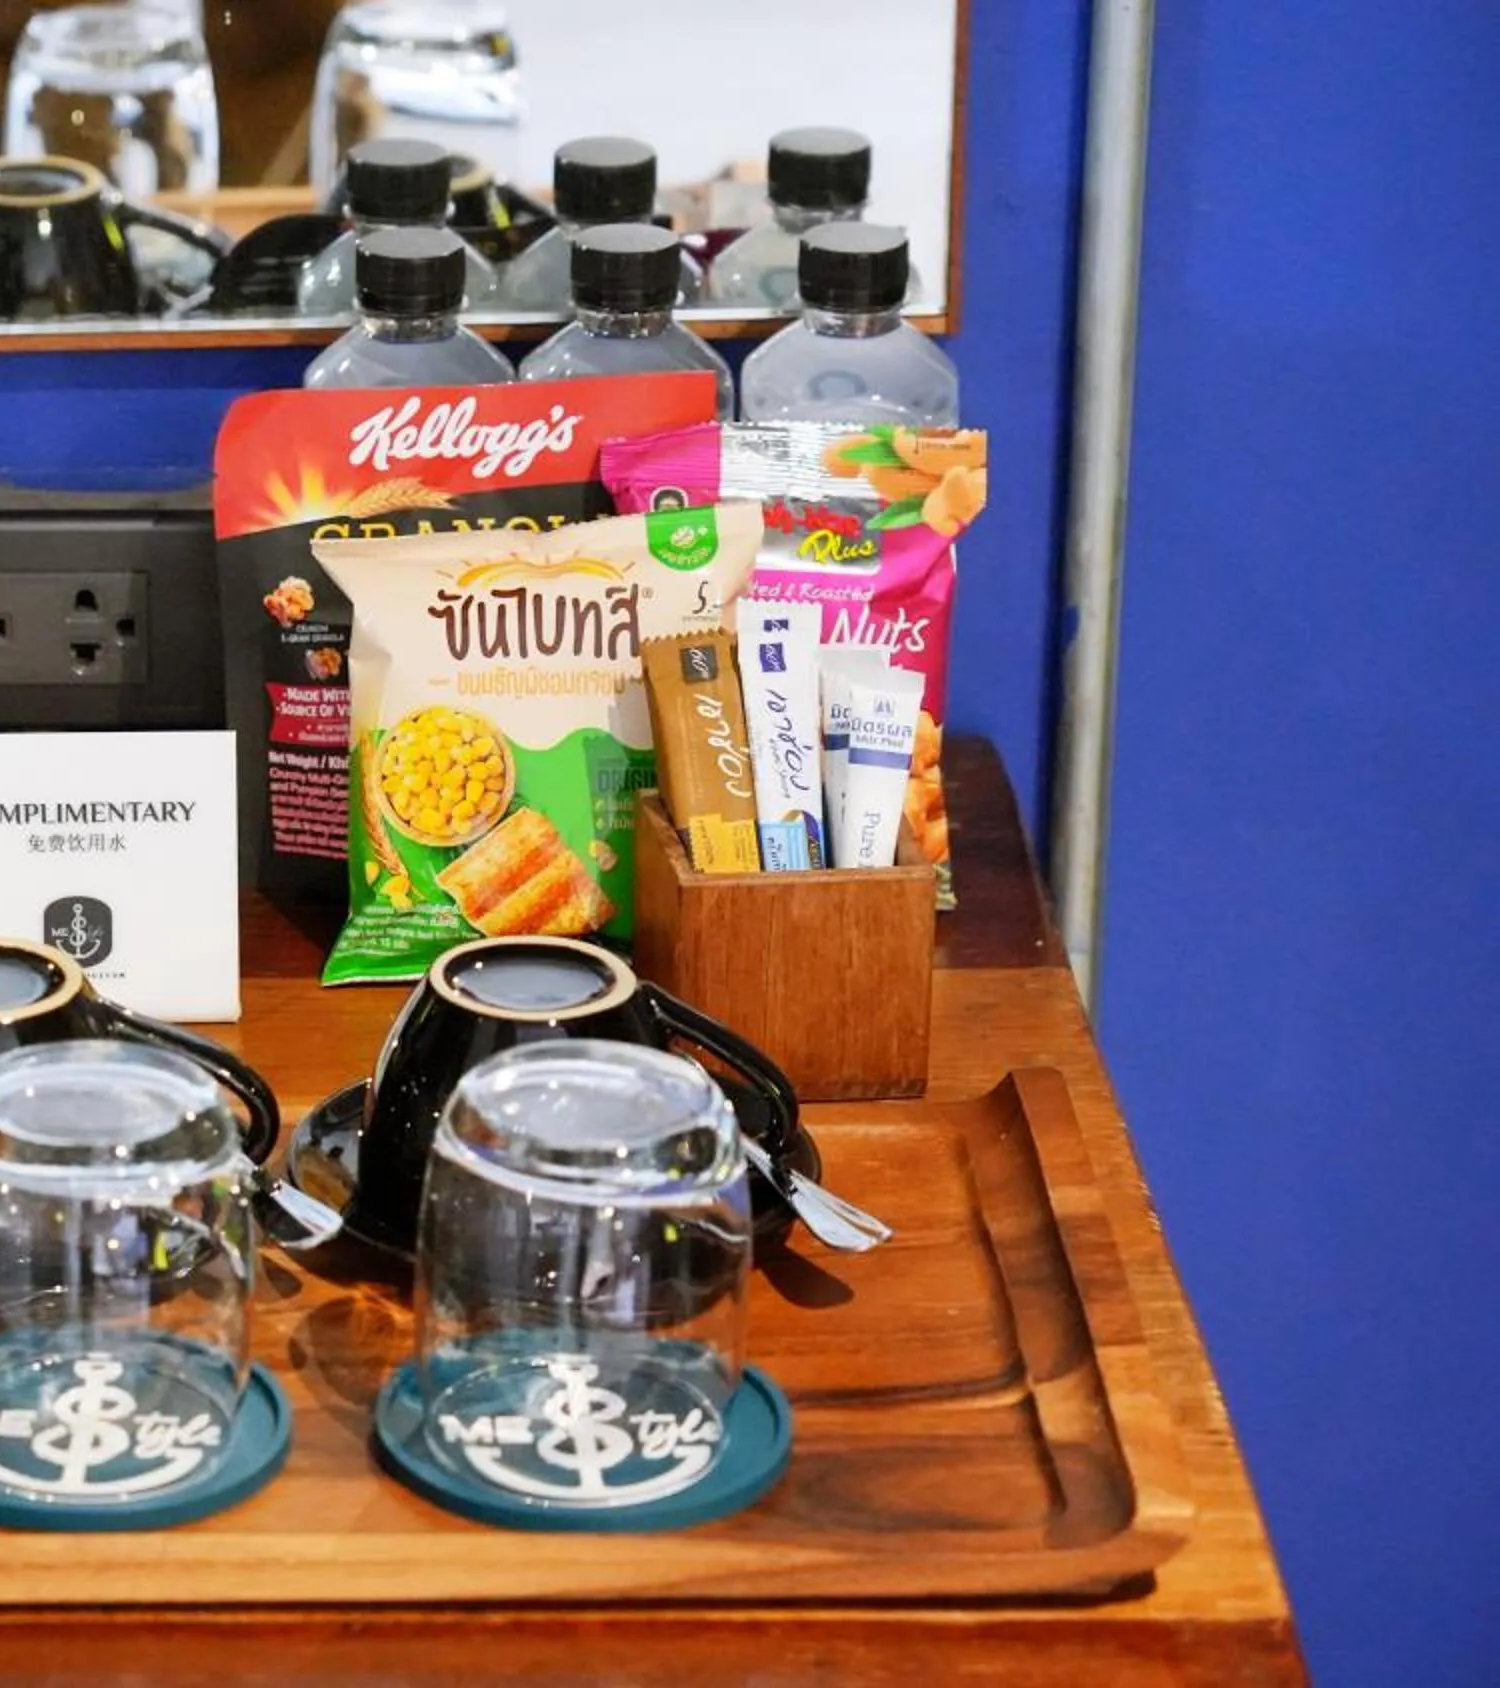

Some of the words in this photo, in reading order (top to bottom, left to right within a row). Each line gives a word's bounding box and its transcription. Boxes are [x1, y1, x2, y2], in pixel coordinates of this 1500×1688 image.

[350, 396, 585, 478] Kellogg's
[797, 528, 876, 566] Plus
[828, 603, 930, 652] Nuts
[27, 832, 127, 854] 免费饮用水
[859, 810, 882, 859] Pure
[438, 1414, 534, 1445] ME
